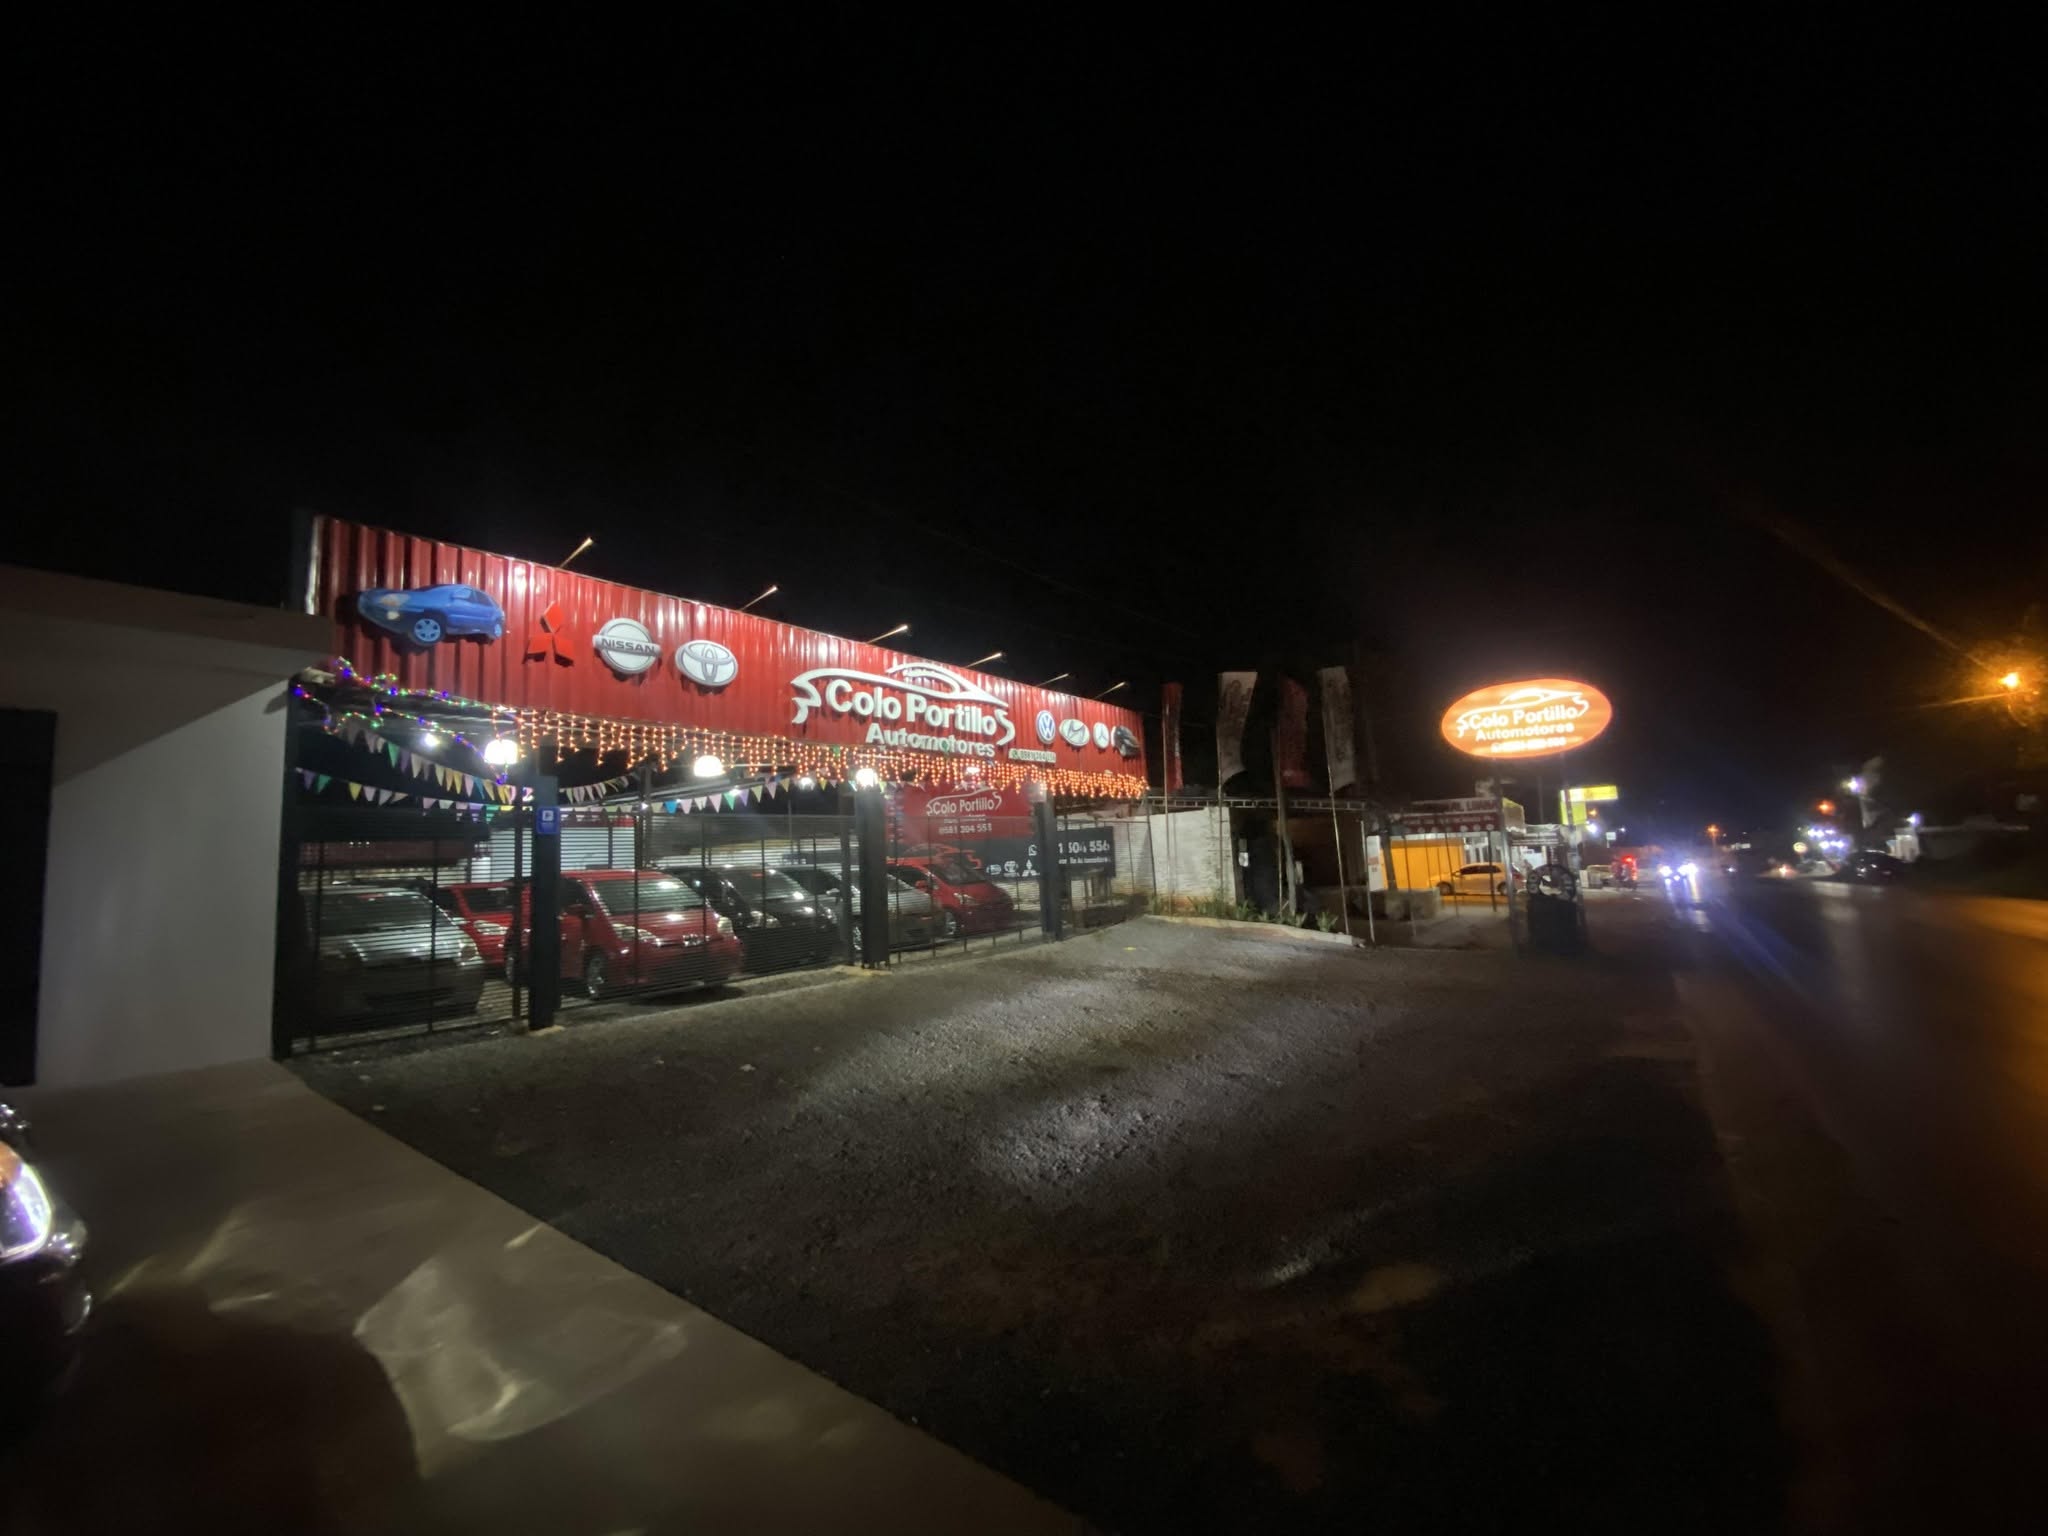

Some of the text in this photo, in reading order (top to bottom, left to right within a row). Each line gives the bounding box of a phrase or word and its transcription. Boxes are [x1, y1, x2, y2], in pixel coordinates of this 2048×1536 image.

[601, 638, 655, 654] NISSAN
[825, 678, 997, 736] Colo Portillo
[1468, 704, 1578, 730] Colo Portillo
[864, 722, 996, 758] Automotores
[1475, 721, 1575, 742] Automotores
[932, 796, 995, 815] Colo Portillo
